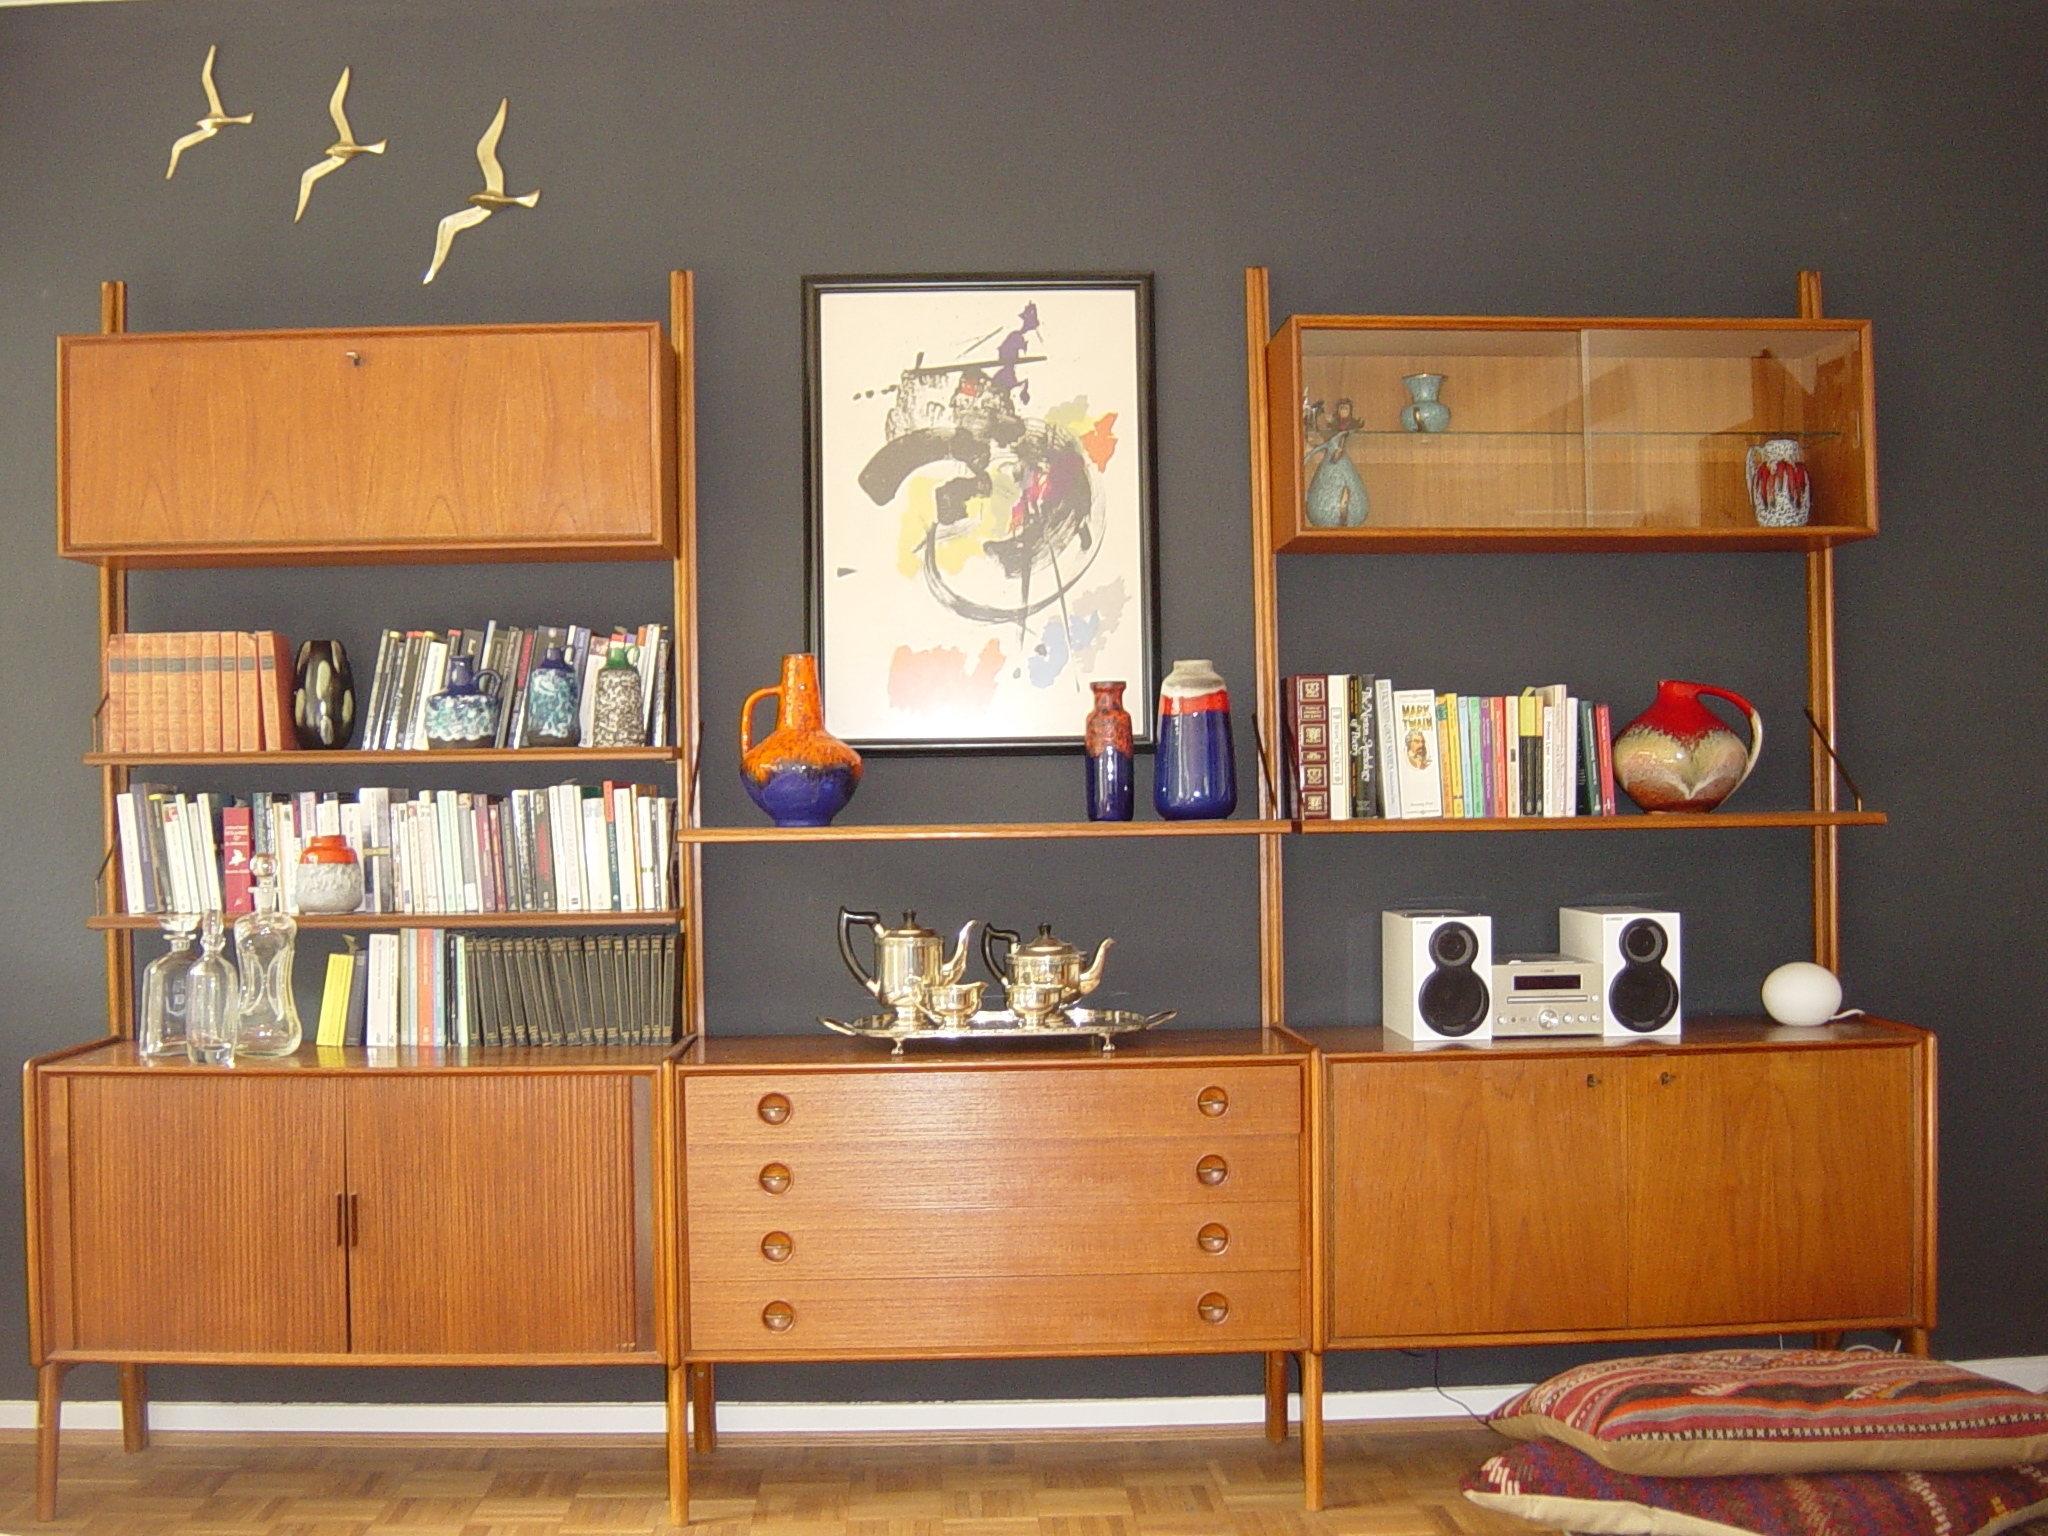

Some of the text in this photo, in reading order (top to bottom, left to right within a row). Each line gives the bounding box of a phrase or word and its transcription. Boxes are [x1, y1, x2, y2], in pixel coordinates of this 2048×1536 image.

[1402, 704, 1430, 716] MARK
[1359, 687, 1374, 782] The Norton Anthology
[1402, 717, 1433, 731] TWAIN
[1350, 728, 1361, 757] Poetry
